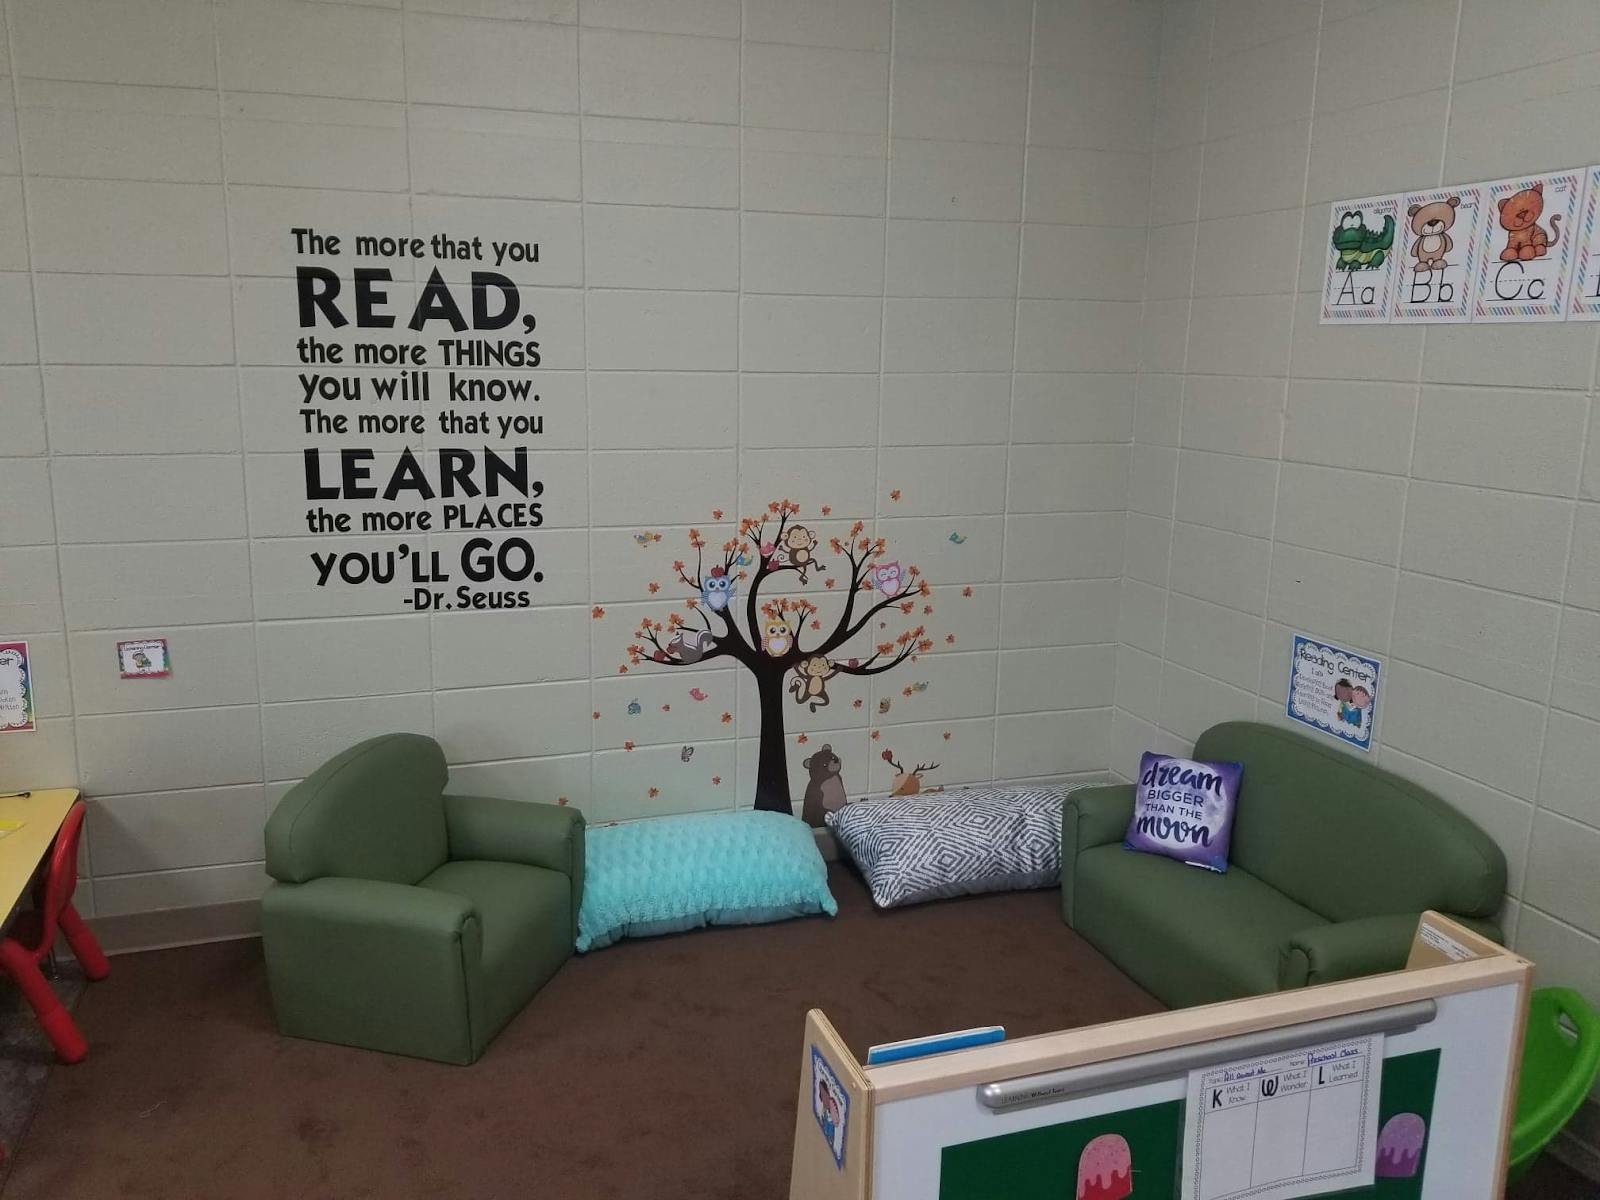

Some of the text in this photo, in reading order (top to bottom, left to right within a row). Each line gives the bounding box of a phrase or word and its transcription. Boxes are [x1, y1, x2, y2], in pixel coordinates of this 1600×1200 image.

[291, 228, 539, 267] The more that you
[1337, 272, 1375, 305] Aa
[1410, 267, 1454, 303] Bb
[1495, 261, 1545, 300] Cc
[296, 265, 537, 334] READ,
[297, 336, 541, 367] the more THINGS
[298, 370, 540, 404] you will know.
[300, 409, 543, 439] The more that you
[304, 445, 544, 501] LEARN,
[306, 503, 544, 533] the more PLACES
[310, 537, 544, 586] YOU'LL GO.
[403, 586, 530, 611] -Dr. Seuss
[1300, 649, 1334, 675] Reading
[1338, 661, 1371, 682] Center
[1142, 762, 1222, 796] dream
[1145, 803, 1202, 820] THAN THE
[1147, 789, 1204, 807] BIGGER
[1136, 815, 1214, 847] moon
[1283, 1072, 1300, 1081] What
[1318, 1066, 1325, 1085] L
[1329, 1071, 1359, 1083] Learned
[1333, 1063, 1350, 1072] What
[1212, 1089, 1223, 1109] K
[1227, 1085, 1244, 1094] What
[1262, 1076, 1279, 1097] W
[1280, 1081, 1308, 1092] Wonder
